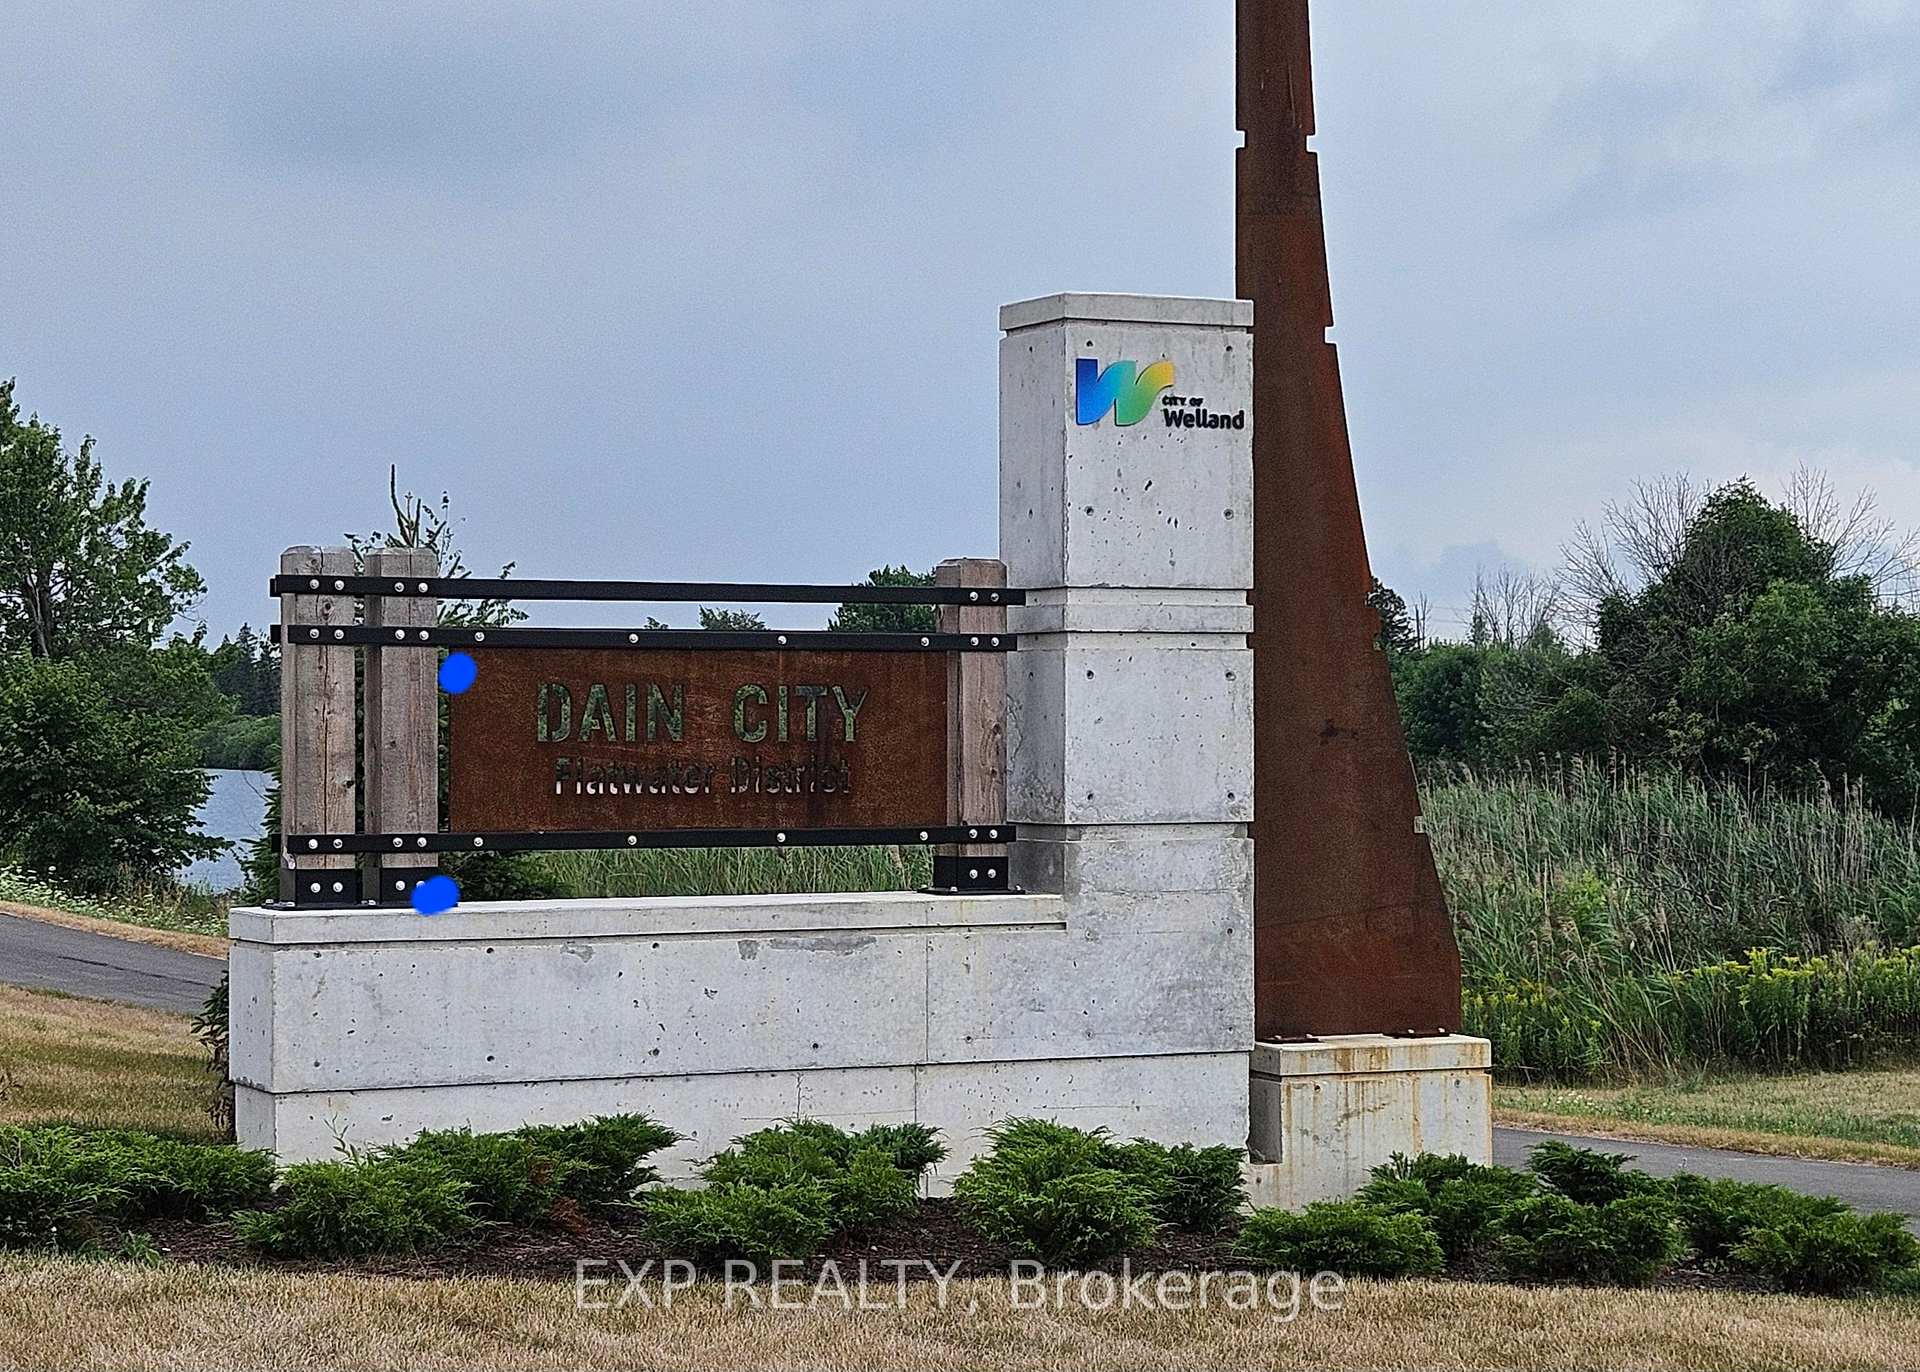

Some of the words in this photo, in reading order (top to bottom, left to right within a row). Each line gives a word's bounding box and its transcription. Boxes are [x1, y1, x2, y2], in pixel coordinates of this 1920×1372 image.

[1161, 396, 1186, 406] CITY
[1189, 397, 1204, 407] OF
[1163, 408, 1245, 430] Welland
[536, 683, 684, 743] DAIN
[734, 683, 870, 743] CITY
[554, 757, 715, 795] Flatwater
[729, 755, 852, 794] District
